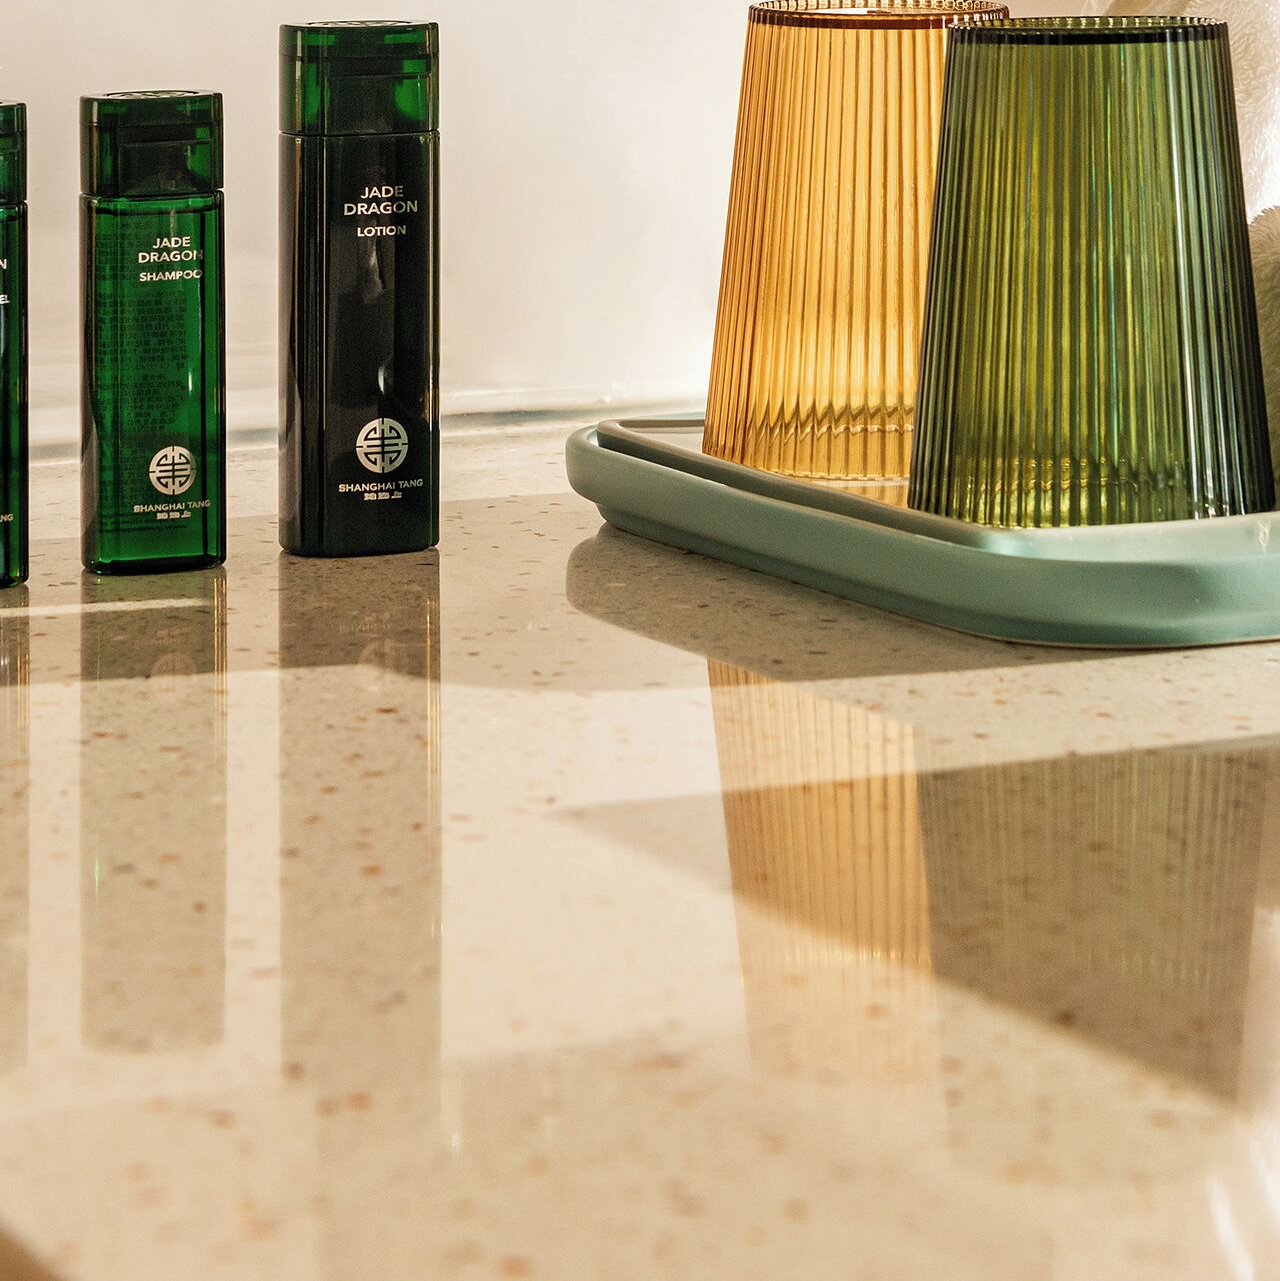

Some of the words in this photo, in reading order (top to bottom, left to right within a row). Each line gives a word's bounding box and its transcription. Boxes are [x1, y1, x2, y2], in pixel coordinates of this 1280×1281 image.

[361, 185, 403, 199] JADE
[344, 201, 418, 215] DRAGON
[357, 225, 406, 237] LOTION
[153, 237, 191, 249] JADE
[140, 270, 202, 281] SHAMPOO
[338, 482, 395, 493] SHANGHAI
[398, 479, 423, 488] TANG
[134, 502, 185, 513] SHANGHAI
[188, 500, 211, 509] TANG
